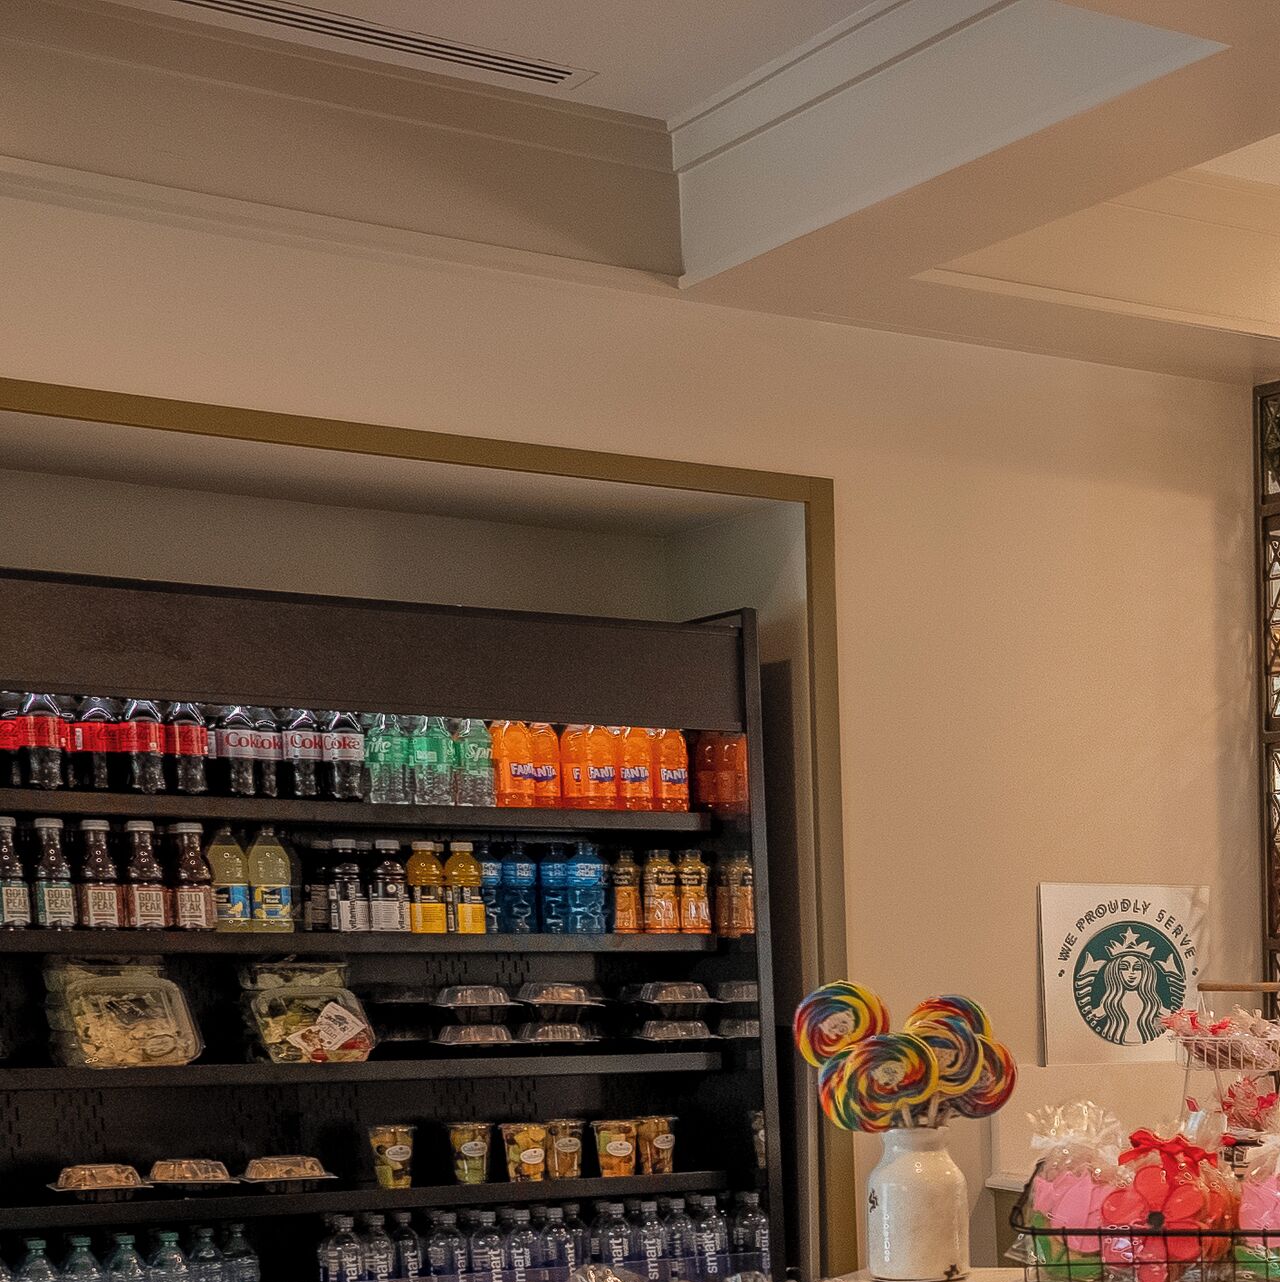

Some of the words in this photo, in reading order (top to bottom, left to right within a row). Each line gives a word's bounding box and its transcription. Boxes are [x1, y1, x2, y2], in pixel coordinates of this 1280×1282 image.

[226, 732, 254, 750] Cok
[291, 733, 322, 750] Cok
[324, 733, 360, 750] Coke
[48, 888, 71, 899] GOLD
[92, 891, 114, 901] GOLD
[139, 892, 161, 902] GOLD
[49, 900, 72, 911] PEAK
[93, 902, 115, 911] PEAK
[139, 902, 162, 912] PEAK
[180, 903, 201, 912] PEAK
[1058, 933, 1078, 962] WE
[1076, 899, 1151, 932] PROUDLY
[1155, 909, 1197, 959] SERVE
[643, 1238, 659, 1280] smart
